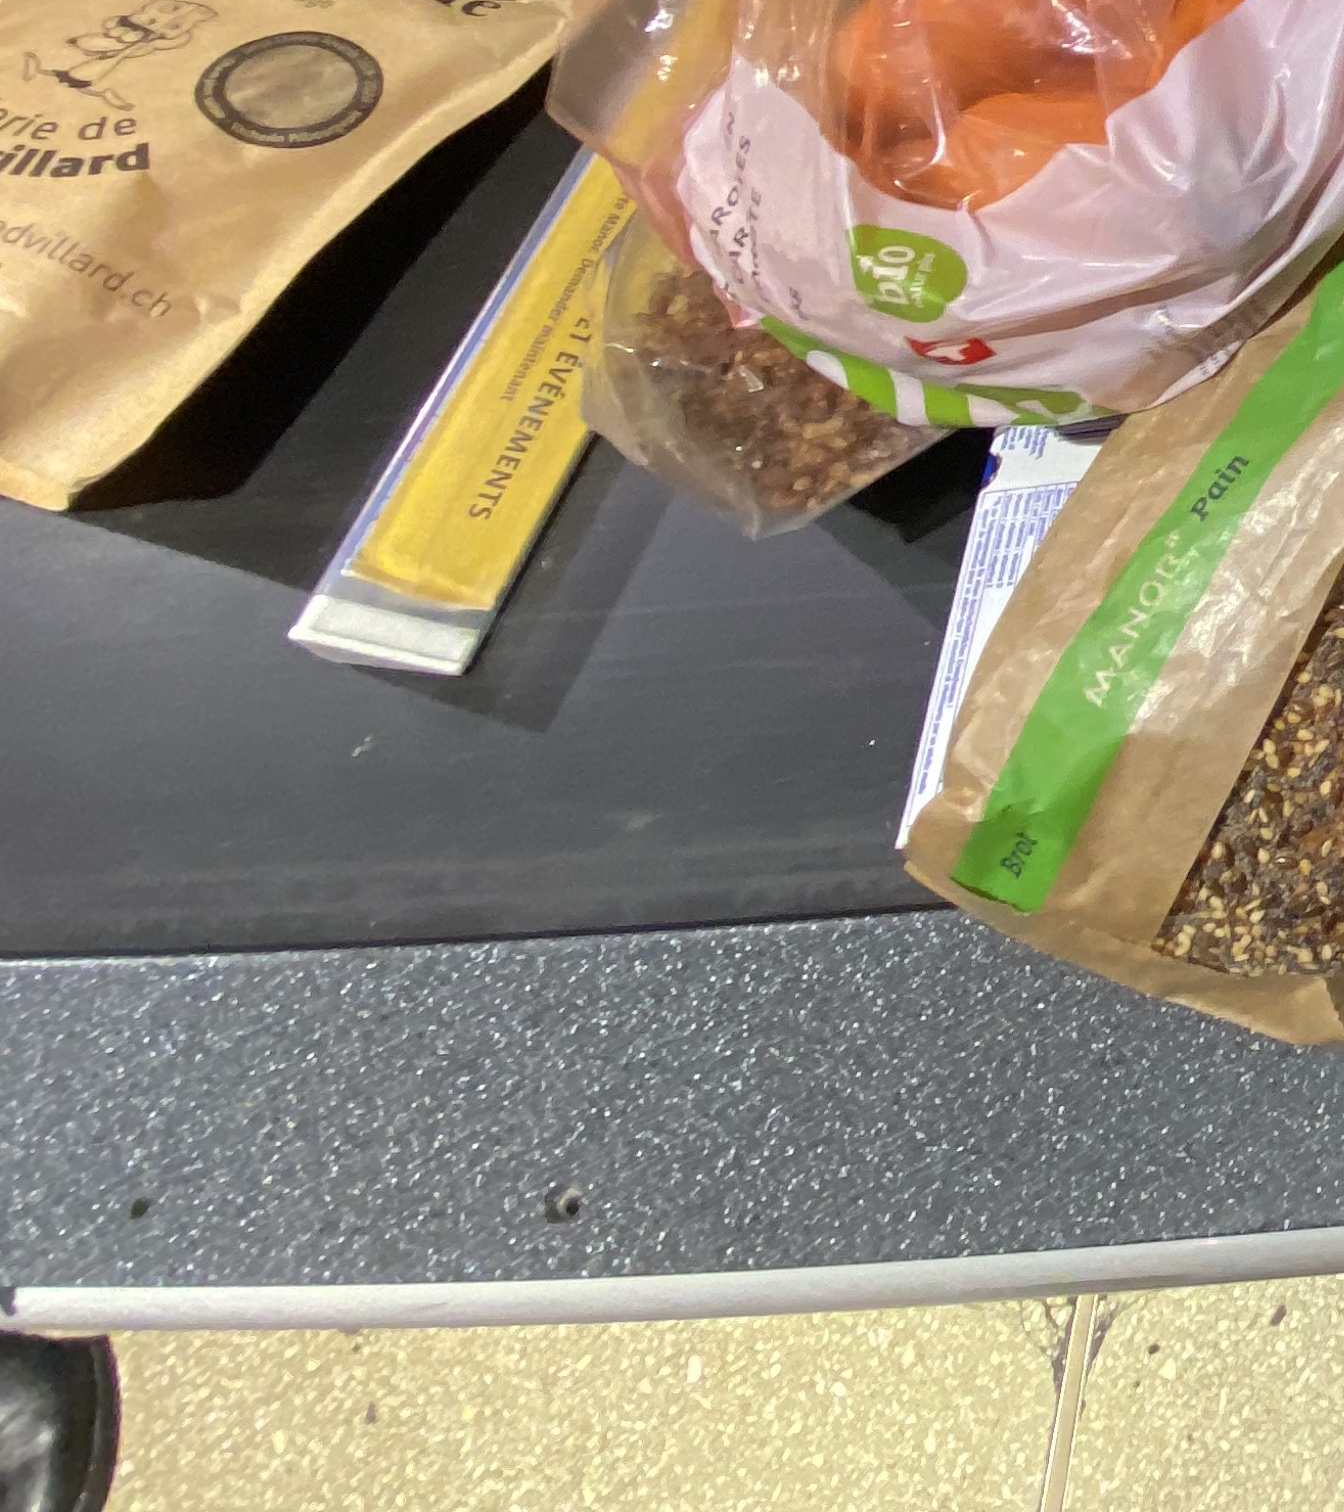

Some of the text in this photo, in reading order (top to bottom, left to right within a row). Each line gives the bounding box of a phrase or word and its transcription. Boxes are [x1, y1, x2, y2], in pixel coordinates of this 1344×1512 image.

[78, 114, 138, 141] de
[549, 256, 594, 329] Demander
[874, 244, 917, 306] bio
[500, 318, 553, 402] maintenant
[468, 349, 583, 522] ÉVÉNEMENTS
[1191, 454, 1250, 522] Pain
[1000, 831, 1039, 879] Brot
